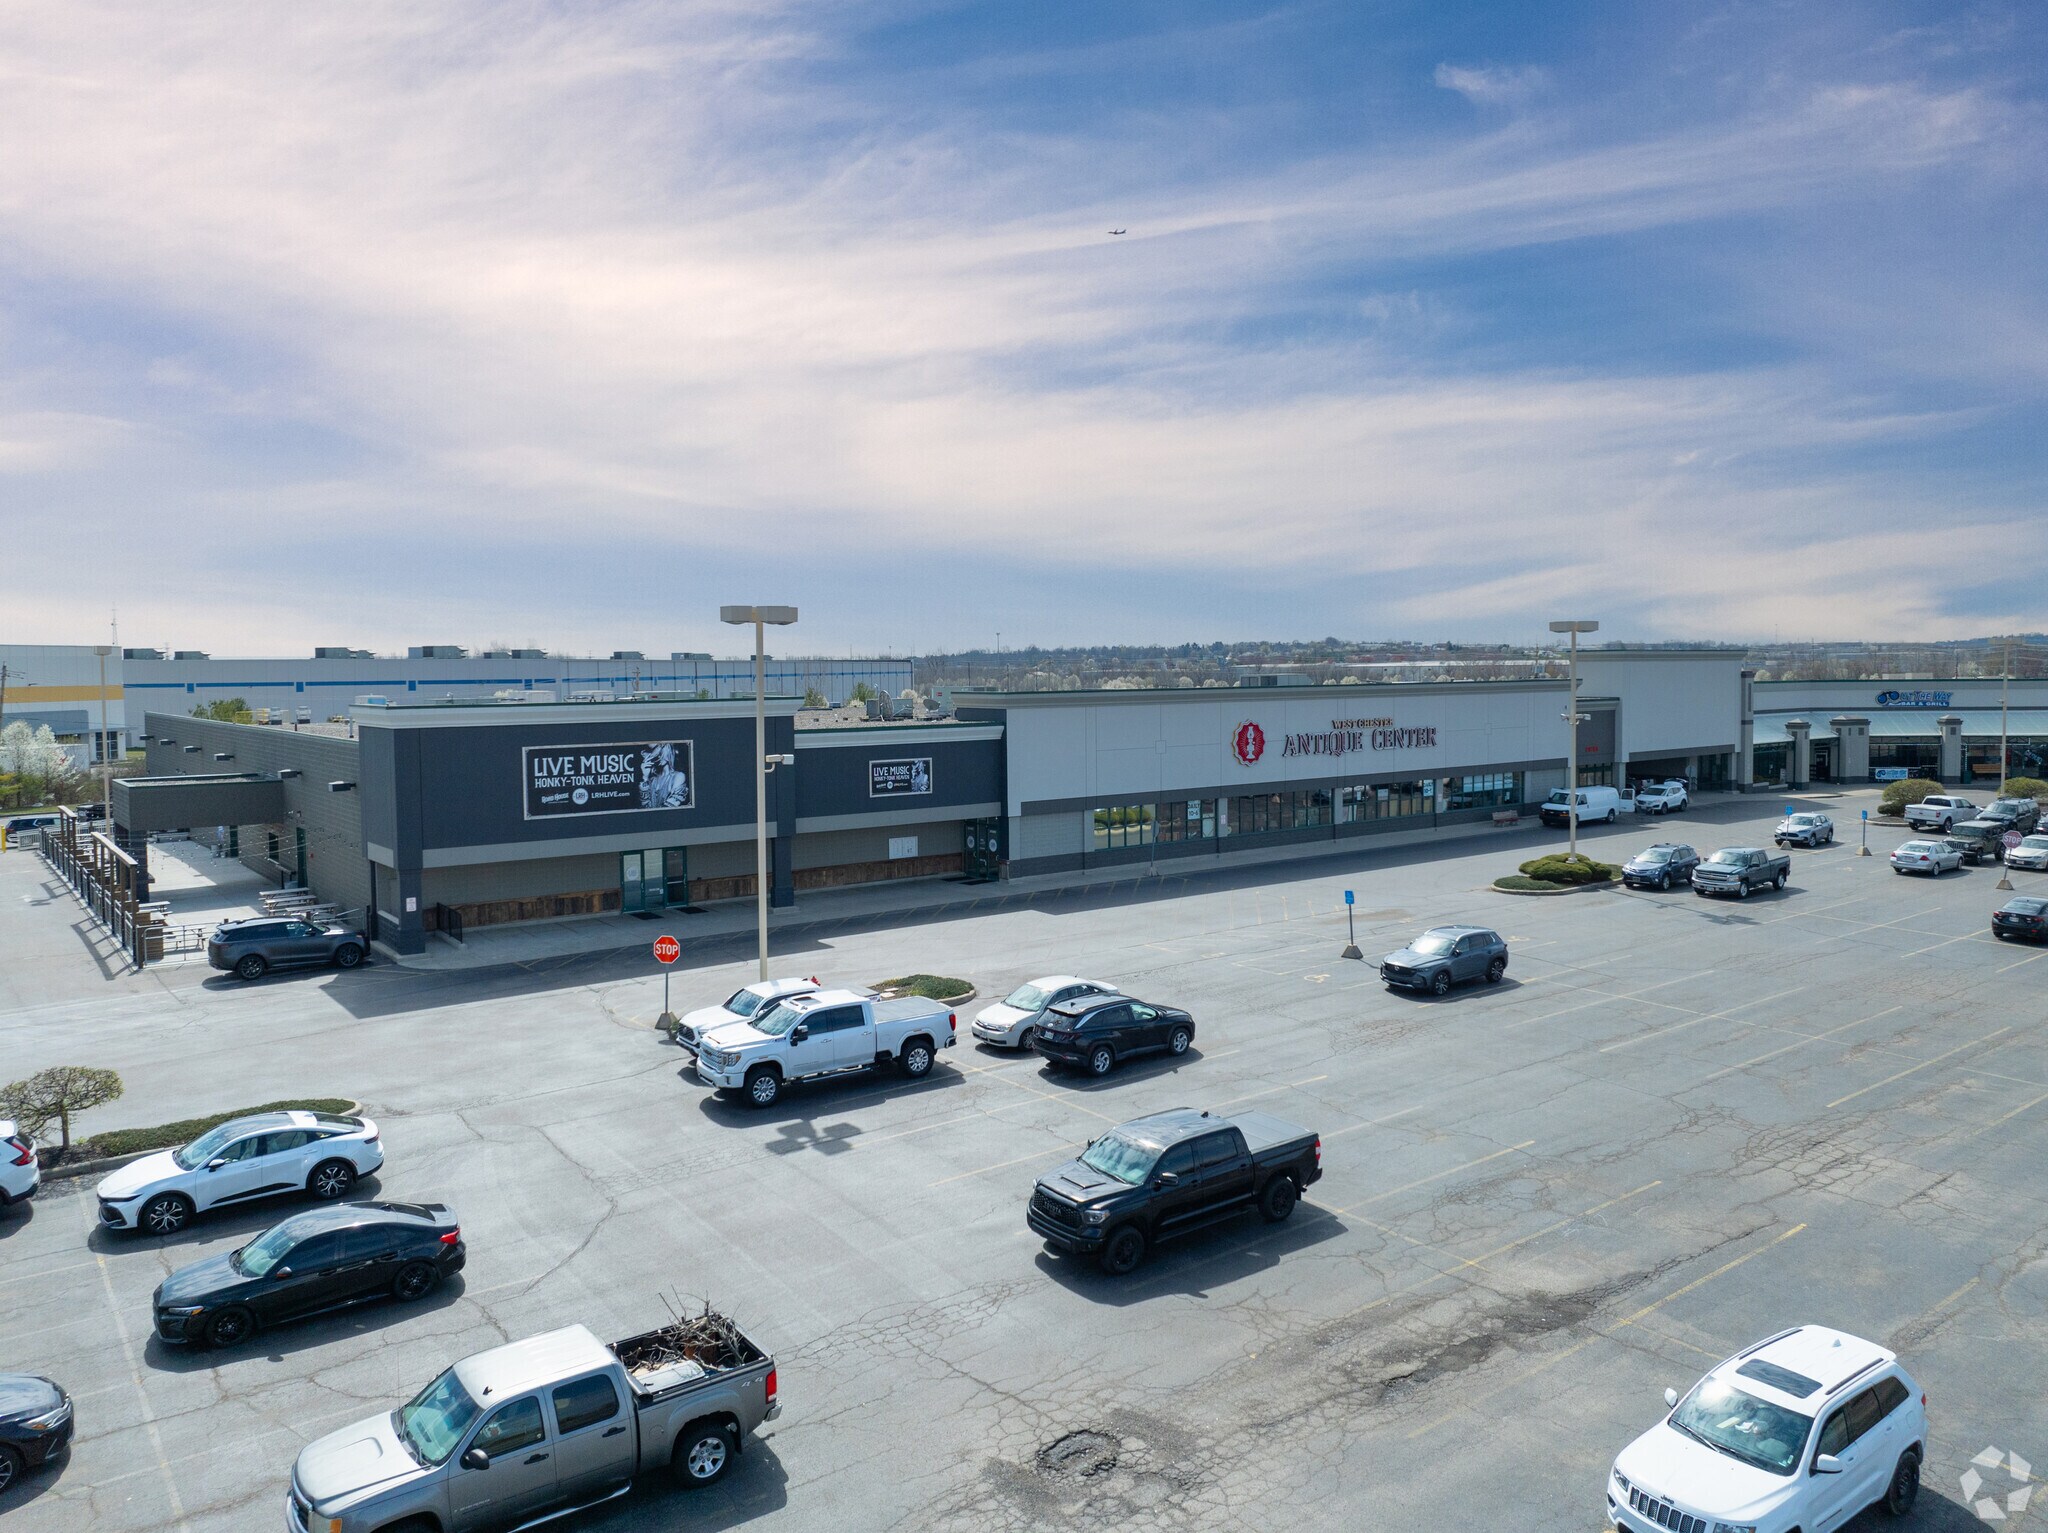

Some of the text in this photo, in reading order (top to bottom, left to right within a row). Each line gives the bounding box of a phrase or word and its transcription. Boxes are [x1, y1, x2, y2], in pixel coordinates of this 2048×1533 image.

[1932, 690, 1954, 701] WAY
[1357, 717, 1393, 728] CHESTER
[1282, 727, 1438, 757] ANTIQUE CENTER
[534, 753, 635, 777] LIVE MUSIC
[873, 765, 910, 777] LIVE MUSIC
[534, 773, 635, 789] HONKY-TONK HEAVEN
[2004, 835, 2022, 844] STOP
[655, 943, 679, 956] STOP
